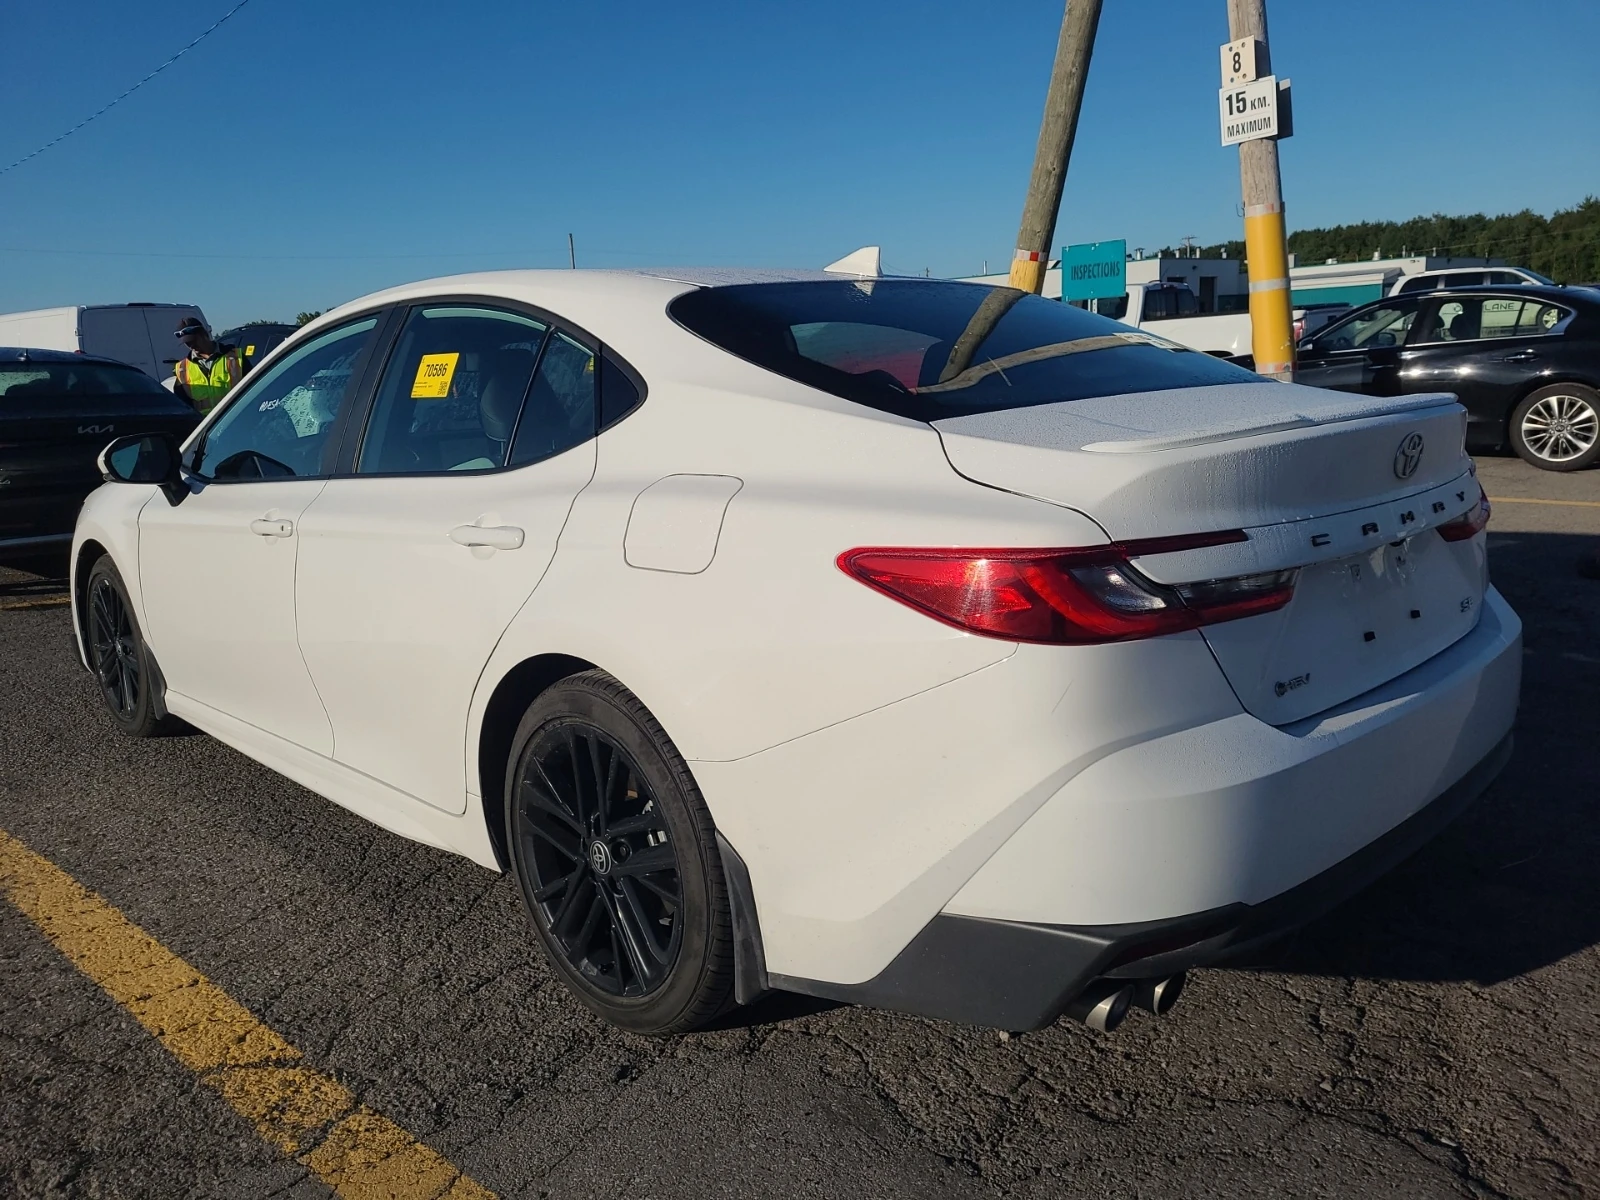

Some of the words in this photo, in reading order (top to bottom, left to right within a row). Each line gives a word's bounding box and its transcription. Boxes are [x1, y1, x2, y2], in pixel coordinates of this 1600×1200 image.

[1233, 51, 1241, 73] 8
[1226, 91, 1247, 115] 15
[1250, 96, 1270, 111] KM.
[1227, 117, 1271, 138] MAXIMUM
[1071, 261, 1120, 280] INSPECTIONS
[1484, 303, 1514, 311] LANE
[424, 363, 448, 377] 70586
[1310, 491, 1465, 547] CAMRY
